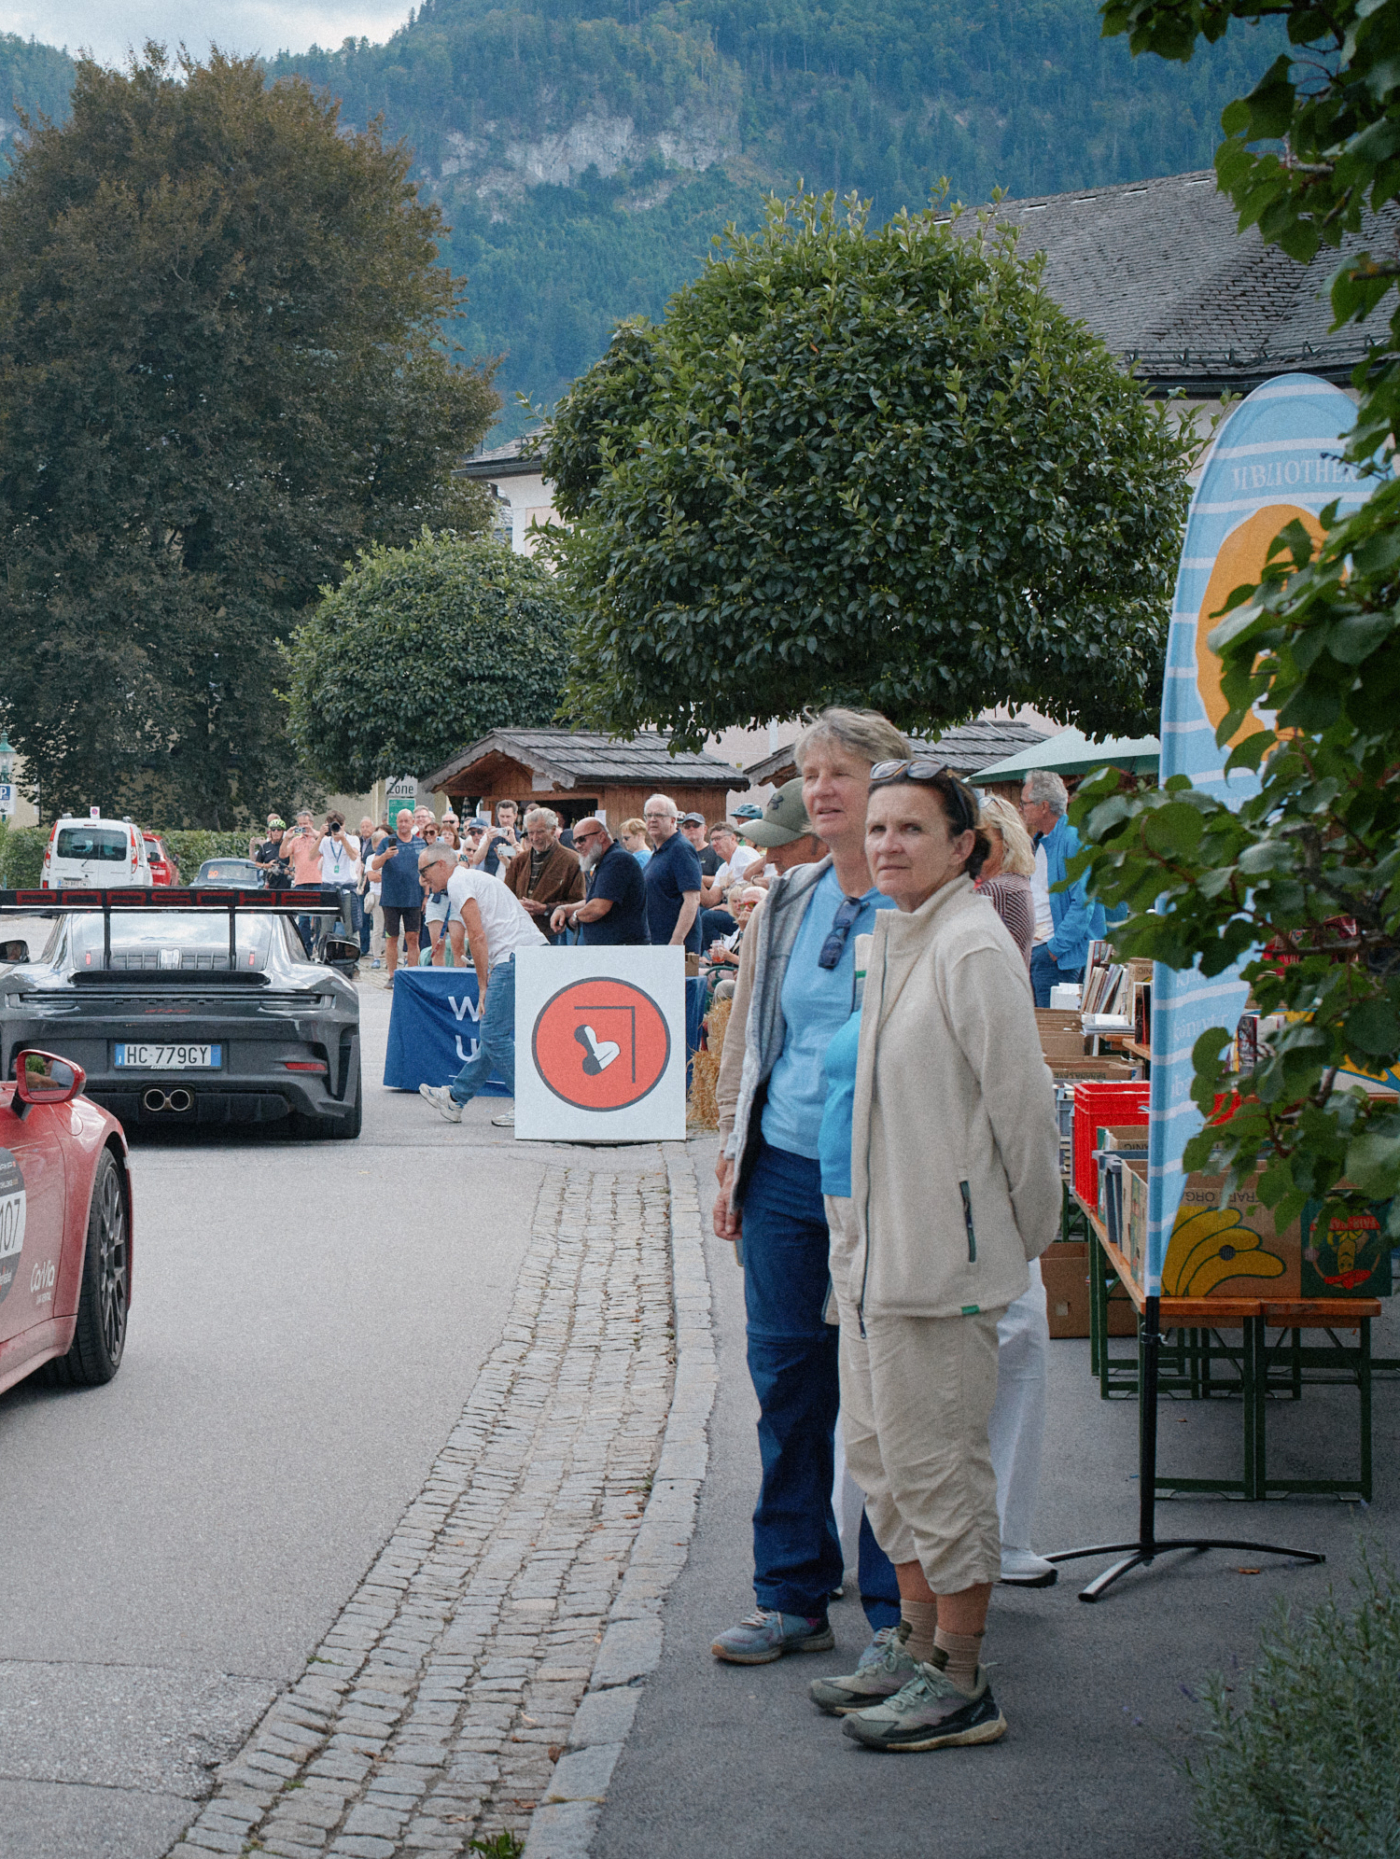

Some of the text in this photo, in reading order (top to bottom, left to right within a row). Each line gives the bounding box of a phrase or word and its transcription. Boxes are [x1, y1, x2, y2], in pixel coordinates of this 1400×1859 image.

[16, 890, 321, 906] PORSCHE
[126, 1046, 208, 1064] HC 779GY
[0, 1198, 21, 1253] 107
